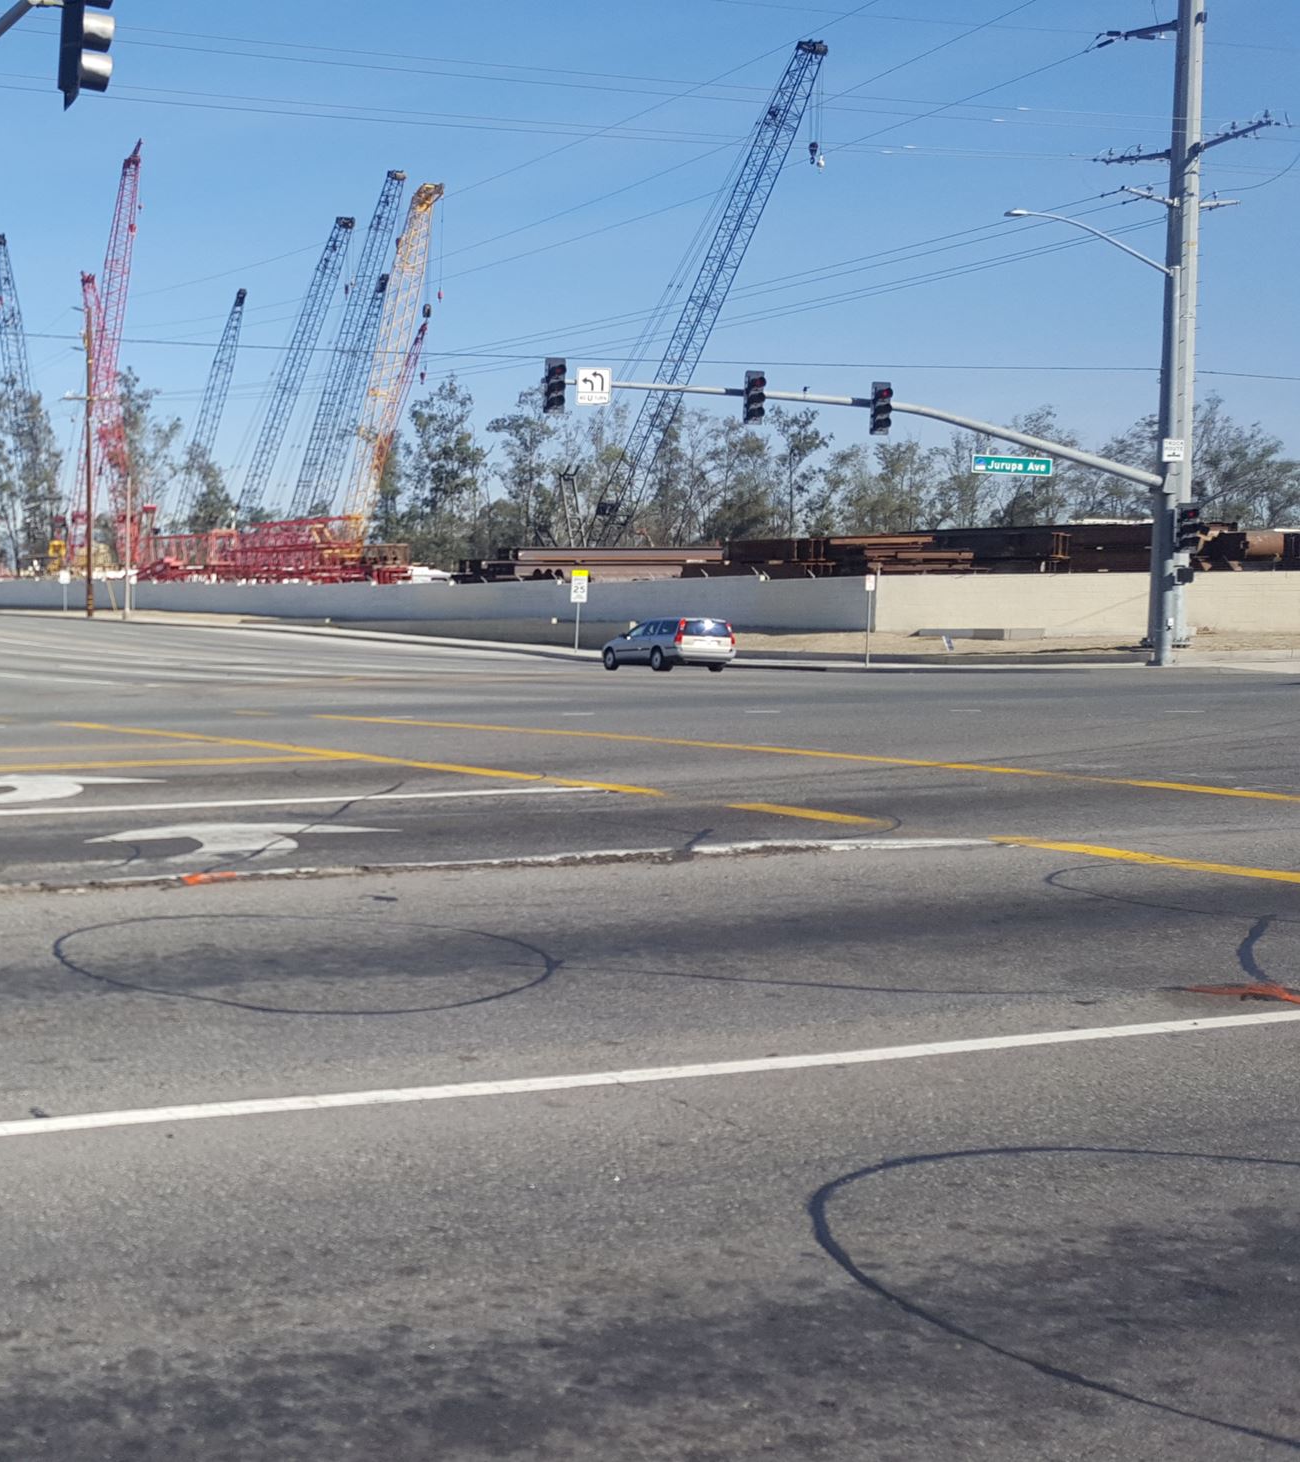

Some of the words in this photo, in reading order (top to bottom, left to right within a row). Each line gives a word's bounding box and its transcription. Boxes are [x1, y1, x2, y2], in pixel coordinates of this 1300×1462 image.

[987, 460, 1024, 472] Jurupa
[1027, 462, 1047, 472] Ave
[573, 585, 586, 594] 25
